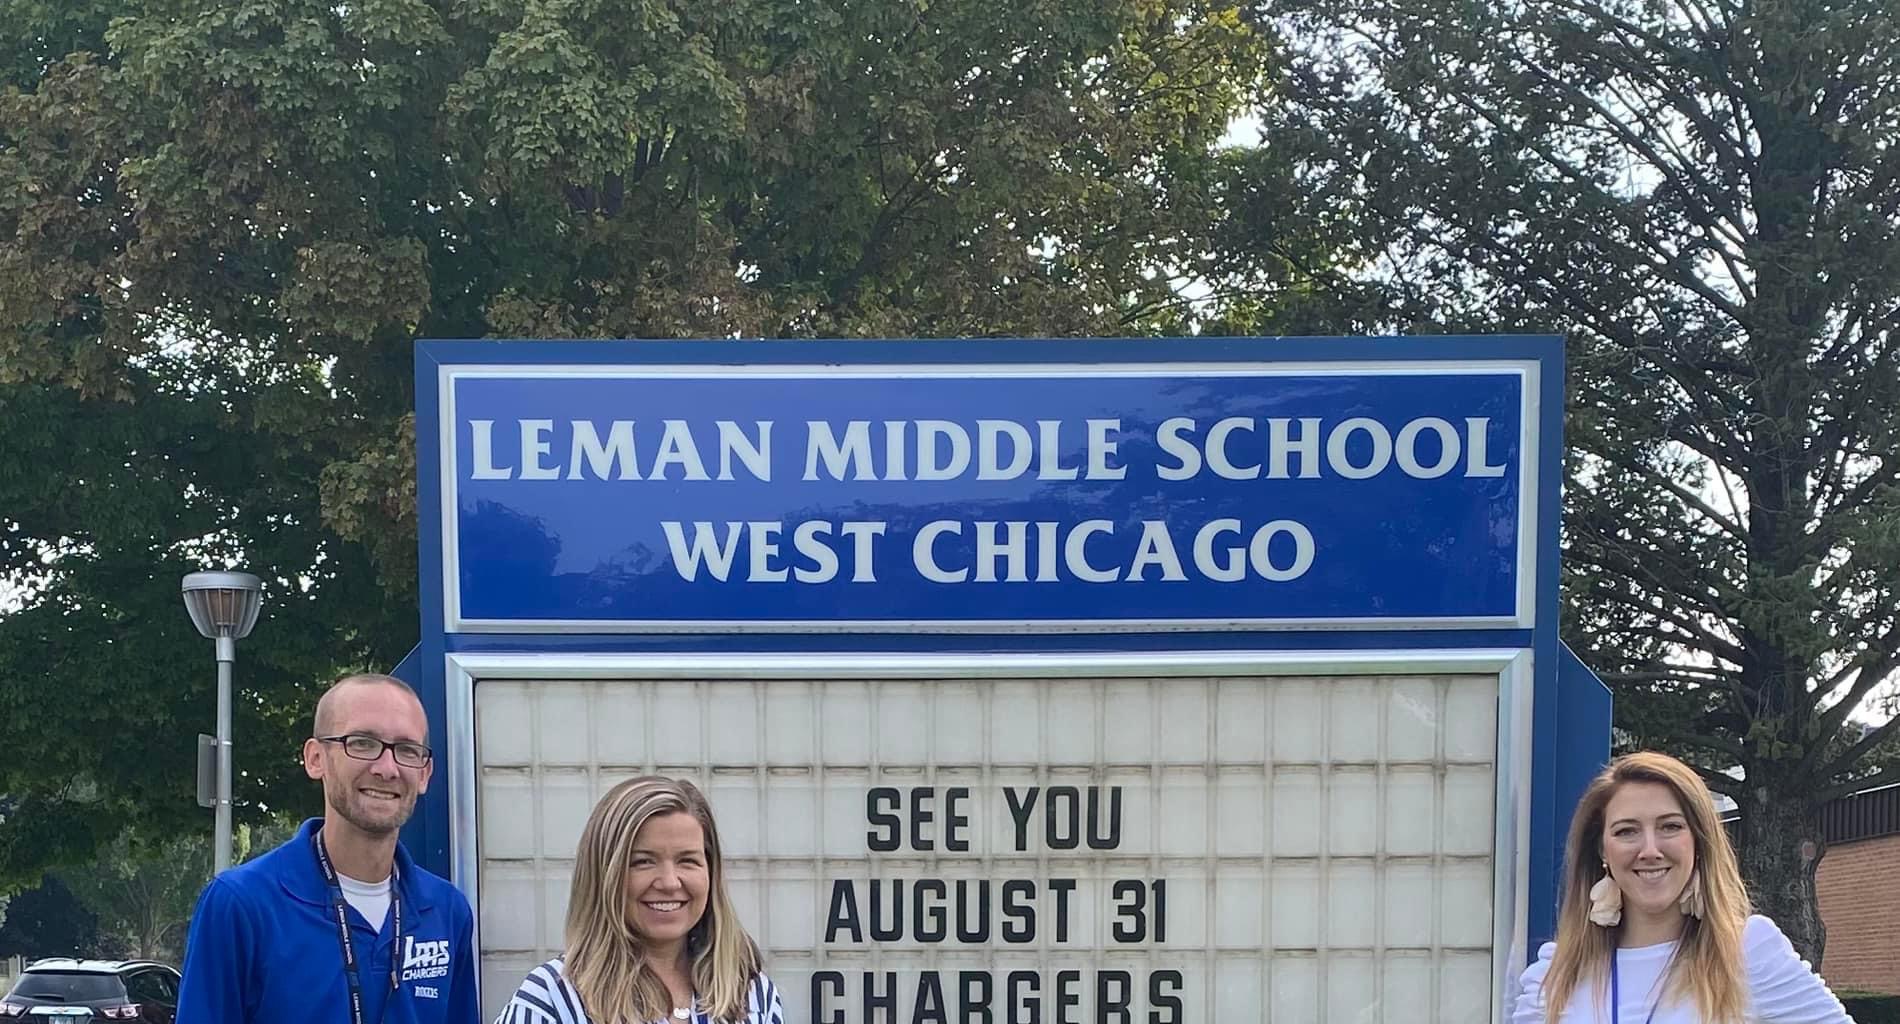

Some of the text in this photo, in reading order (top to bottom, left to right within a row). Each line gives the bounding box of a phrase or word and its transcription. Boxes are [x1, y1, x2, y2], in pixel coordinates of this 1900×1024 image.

[471, 417, 1507, 481] LEMAN MIDDLE SCHOOL
[662, 518, 1316, 583] WEST CHICAGO
[866, 786, 1122, 852] SEE YOU
[824, 878, 1166, 944] AUGUST 31
[401, 966, 449, 981] CHARGERS
